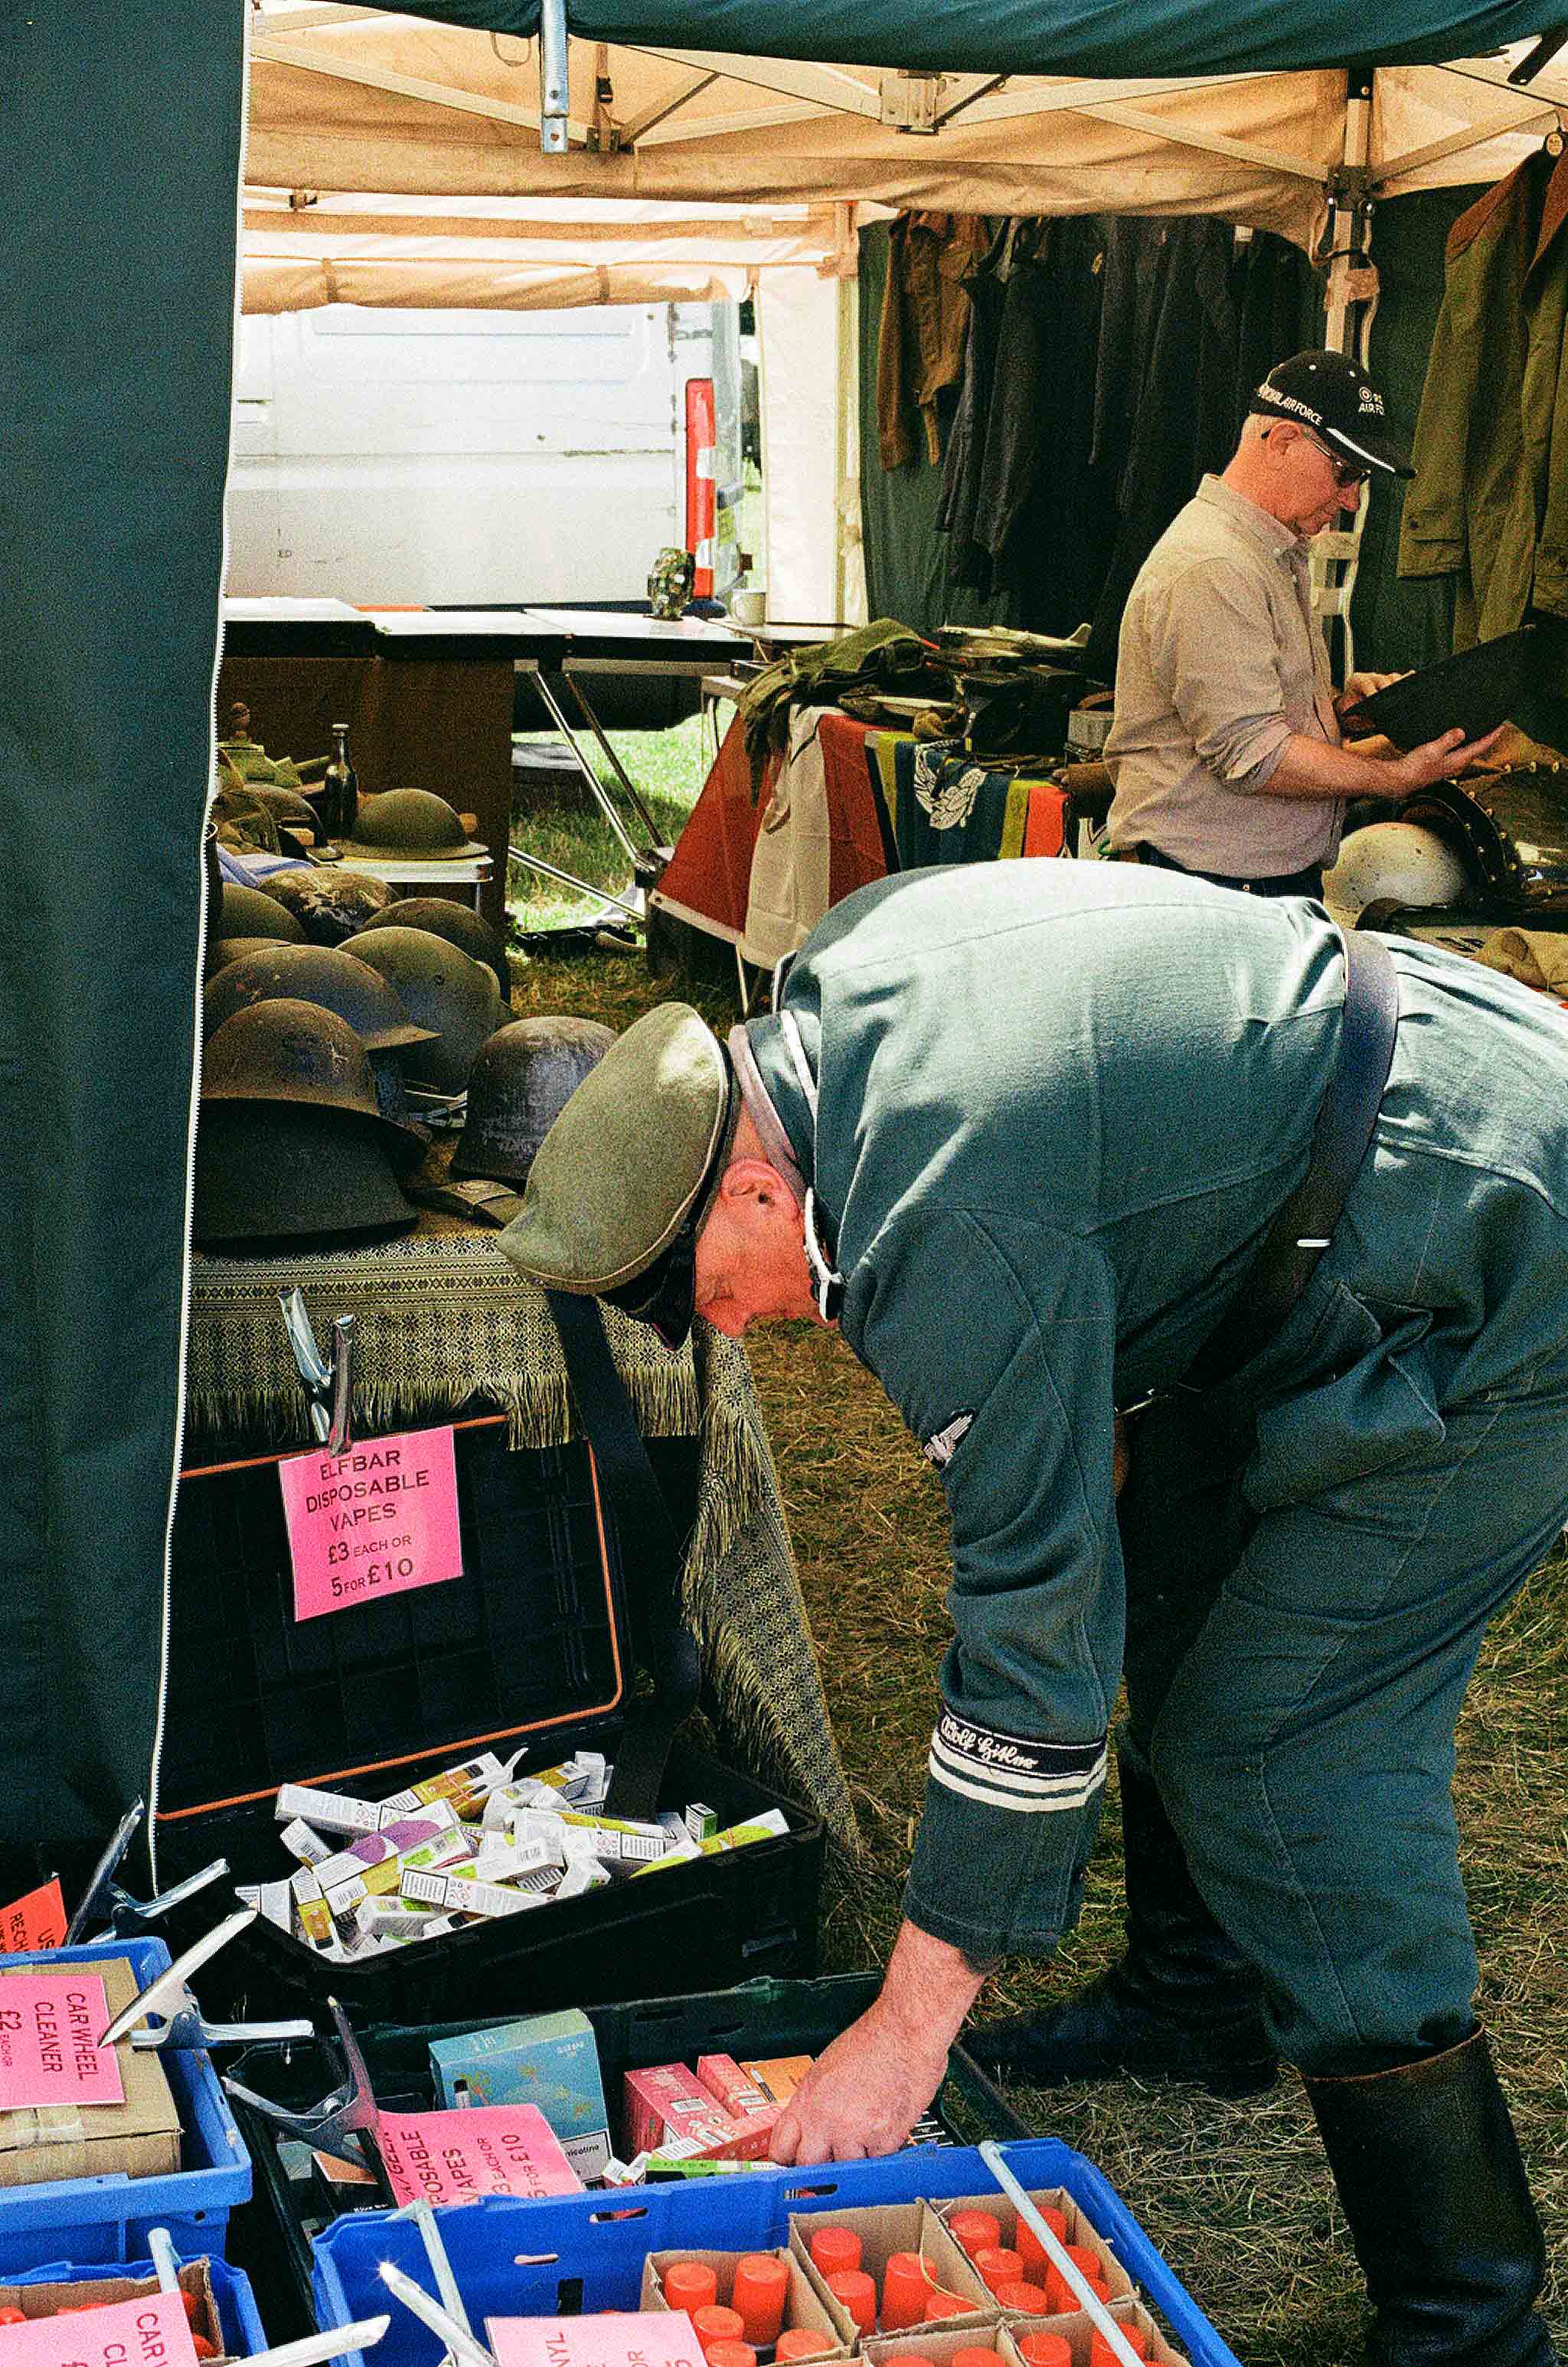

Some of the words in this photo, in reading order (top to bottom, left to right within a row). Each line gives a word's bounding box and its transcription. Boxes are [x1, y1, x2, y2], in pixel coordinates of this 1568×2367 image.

[1295, 402, 1324, 426] FORCE
[306, 1470, 430, 1513] DISPOSABLE
[330, 1502, 397, 1532] VAPES
[328, 1541, 349, 1564] £3
[354, 1538, 388, 1558] EACH
[391, 1534, 412, 1548] OR
[331, 1576, 343, 1597] 5
[344, 1577, 366, 1594] FOR
[368, 1558, 413, 1584] £10
[0, 2010, 21, 2030] £2
[66, 1993, 89, 2024] CAR
[34, 2001, 63, 2073] CLEANER
[72, 2026, 99, 2081] WHEEL
[477, 2137, 492, 2151] OR
[501, 2135, 530, 2161] £10
[442, 2149, 479, 2201] VAPES
[136, 2313, 165, 2360] CAR
